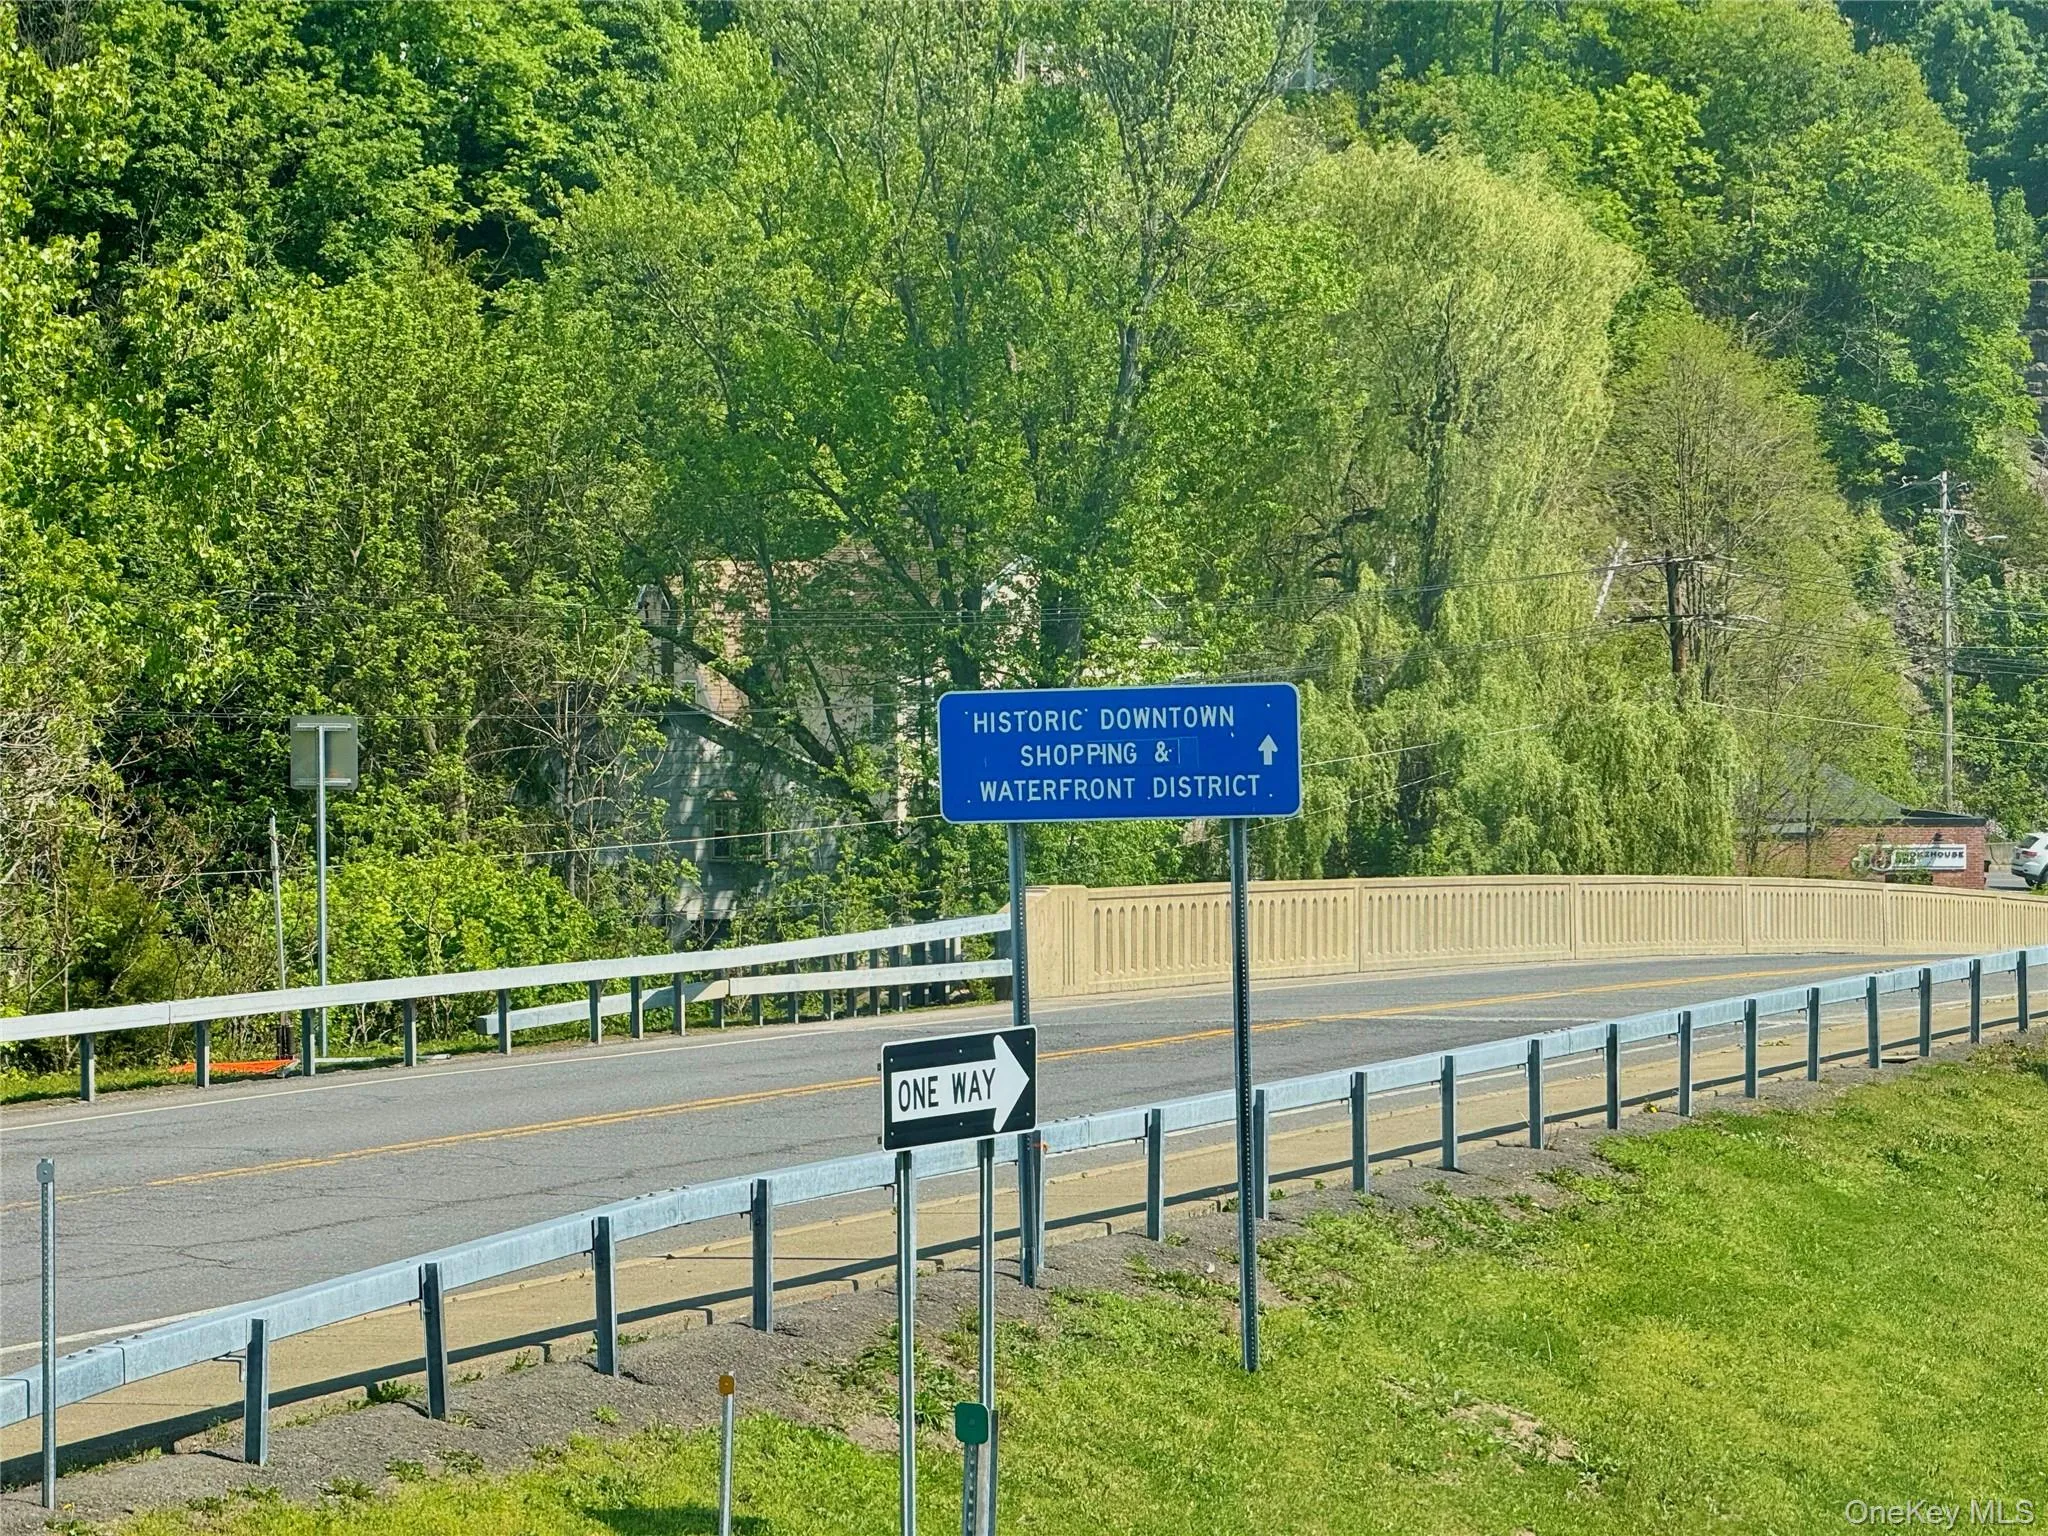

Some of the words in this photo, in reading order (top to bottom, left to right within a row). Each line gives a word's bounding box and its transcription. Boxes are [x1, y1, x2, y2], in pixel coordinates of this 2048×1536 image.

[973, 710, 1084, 734] HISTORIC
[1100, 705, 1235, 730] DOWNTOWN
[1020, 742, 1137, 767] SHOPPING
[1154, 741, 1170, 763] &
[980, 777, 1136, 802] WATERFRONT
[1153, 774, 1260, 799] DISTRICT
[898, 1075, 939, 1112] ONE
[952, 1067, 996, 1105] WAY
